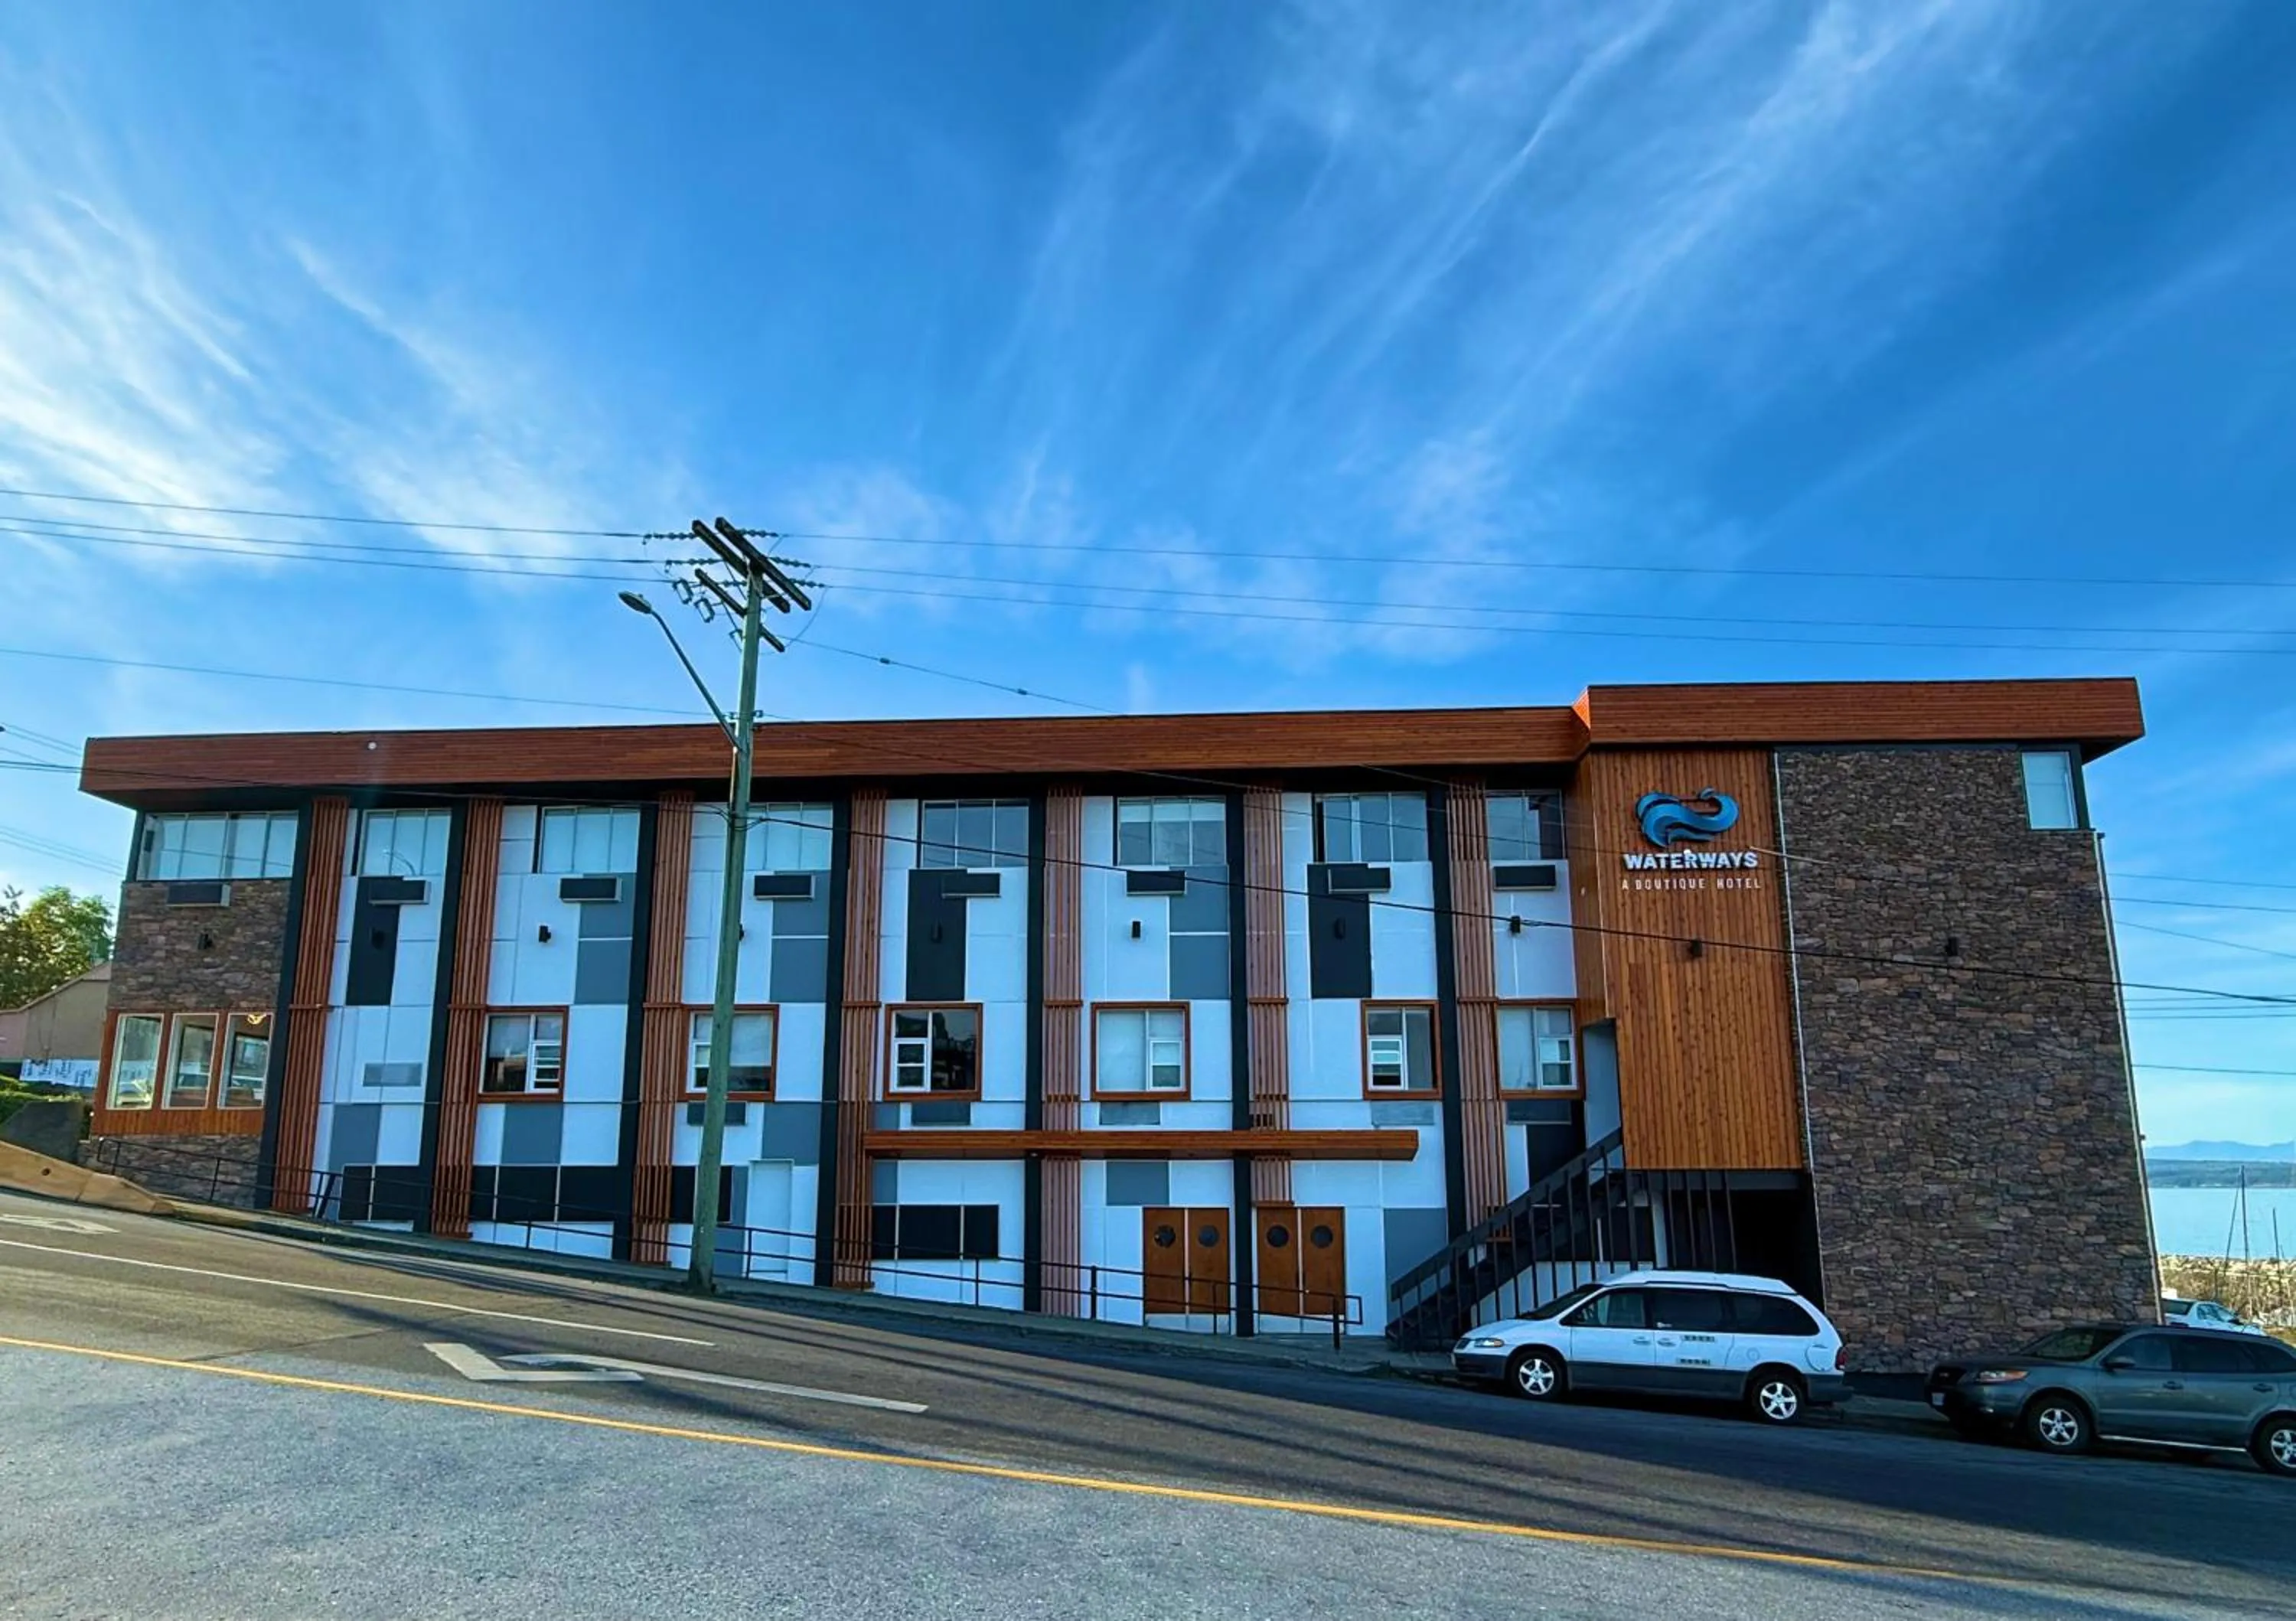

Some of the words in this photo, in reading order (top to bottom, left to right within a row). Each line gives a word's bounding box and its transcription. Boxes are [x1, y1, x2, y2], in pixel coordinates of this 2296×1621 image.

[1623, 851, 1758, 869] WATERWAYS
[1621, 879, 1629, 890] A
[1635, 879, 1706, 890] BOUTIQUE
[1717, 878, 1761, 889] HOTEL
